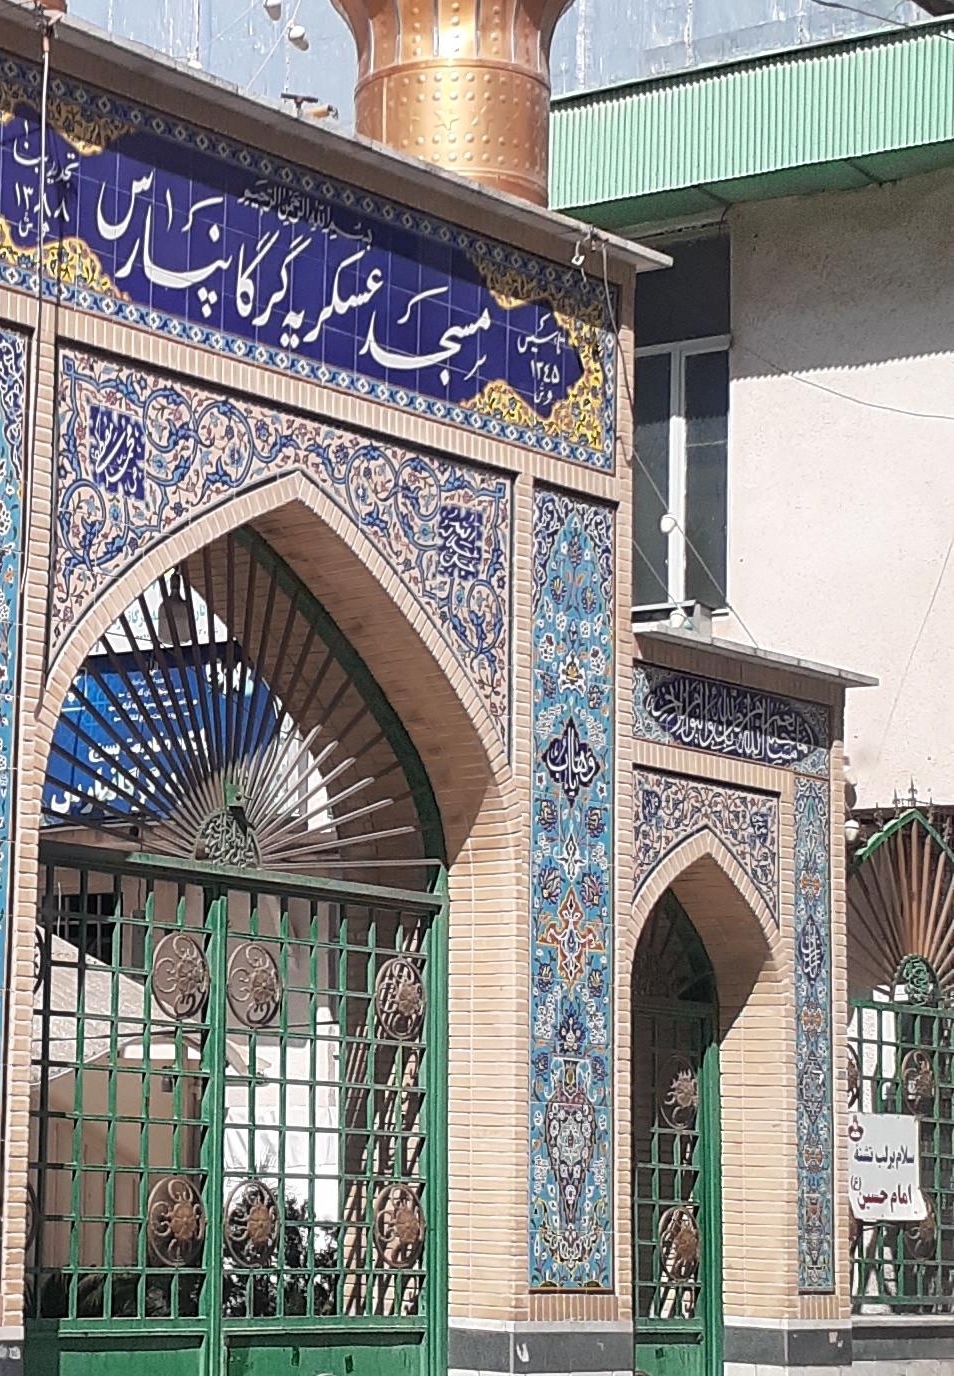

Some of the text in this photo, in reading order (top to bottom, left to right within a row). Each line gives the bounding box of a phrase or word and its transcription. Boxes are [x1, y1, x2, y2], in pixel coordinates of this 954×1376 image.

[308, 200, 332, 231] الله
[282, 248, 385, 349] عسکریه
[359, 307, 492, 385] مسجد
[890, 1183, 912, 1212] امام
